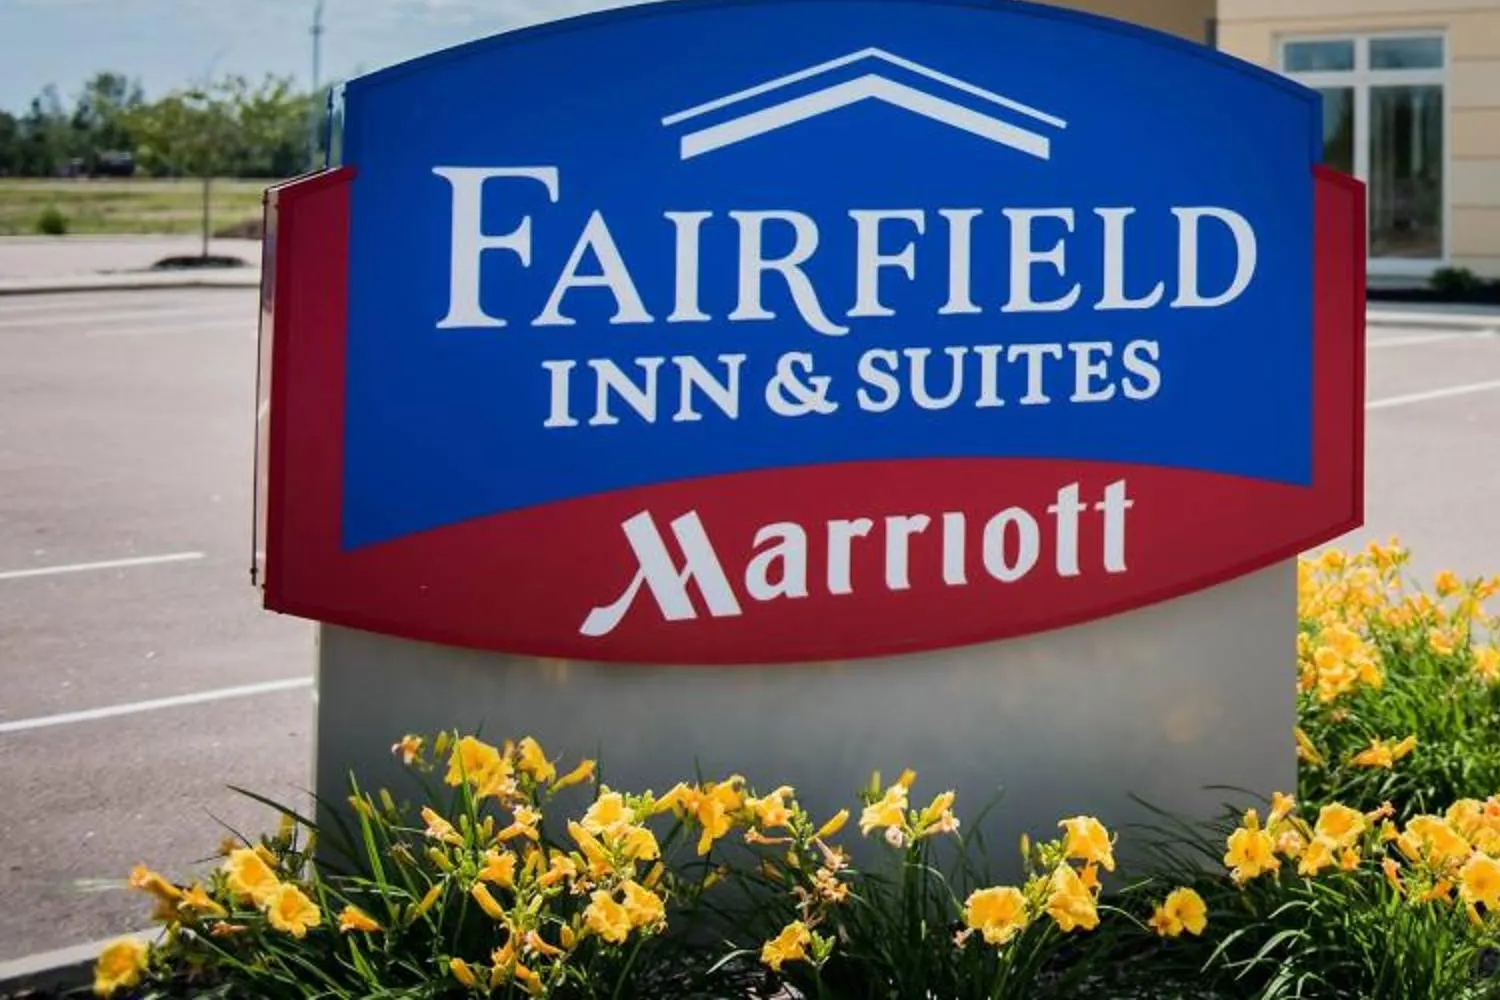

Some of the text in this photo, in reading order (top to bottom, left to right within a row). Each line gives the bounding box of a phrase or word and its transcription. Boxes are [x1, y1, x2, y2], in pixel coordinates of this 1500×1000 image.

[432, 166, 1257, 335] FAIRFIELD
[542, 339, 1161, 427] INN & SUITES
[579, 479, 1134, 637] Marriott
